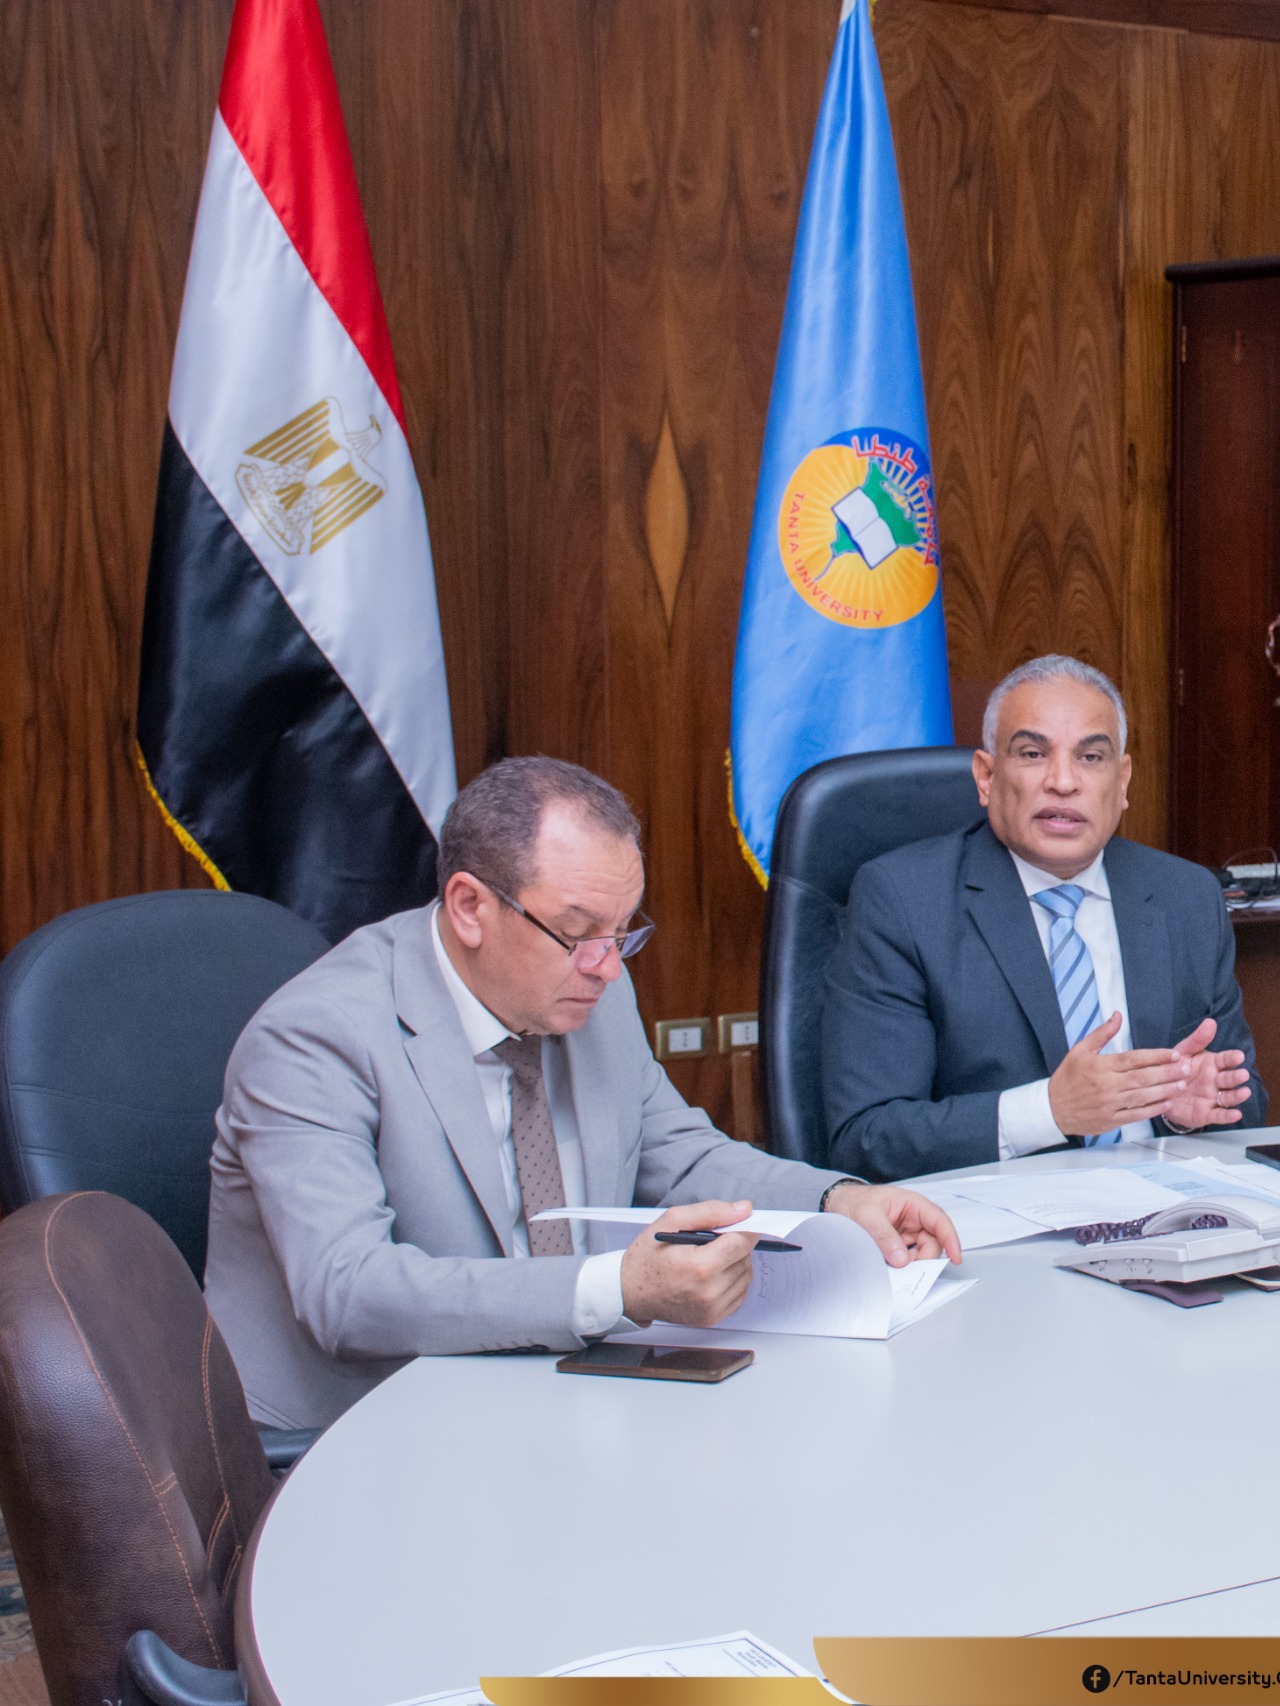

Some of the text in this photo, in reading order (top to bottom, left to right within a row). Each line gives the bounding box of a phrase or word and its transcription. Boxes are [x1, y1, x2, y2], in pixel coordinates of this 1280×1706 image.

[852, 435, 917, 474] طنطا
[789, 492, 884, 621] TANTA UNIVERSITY
